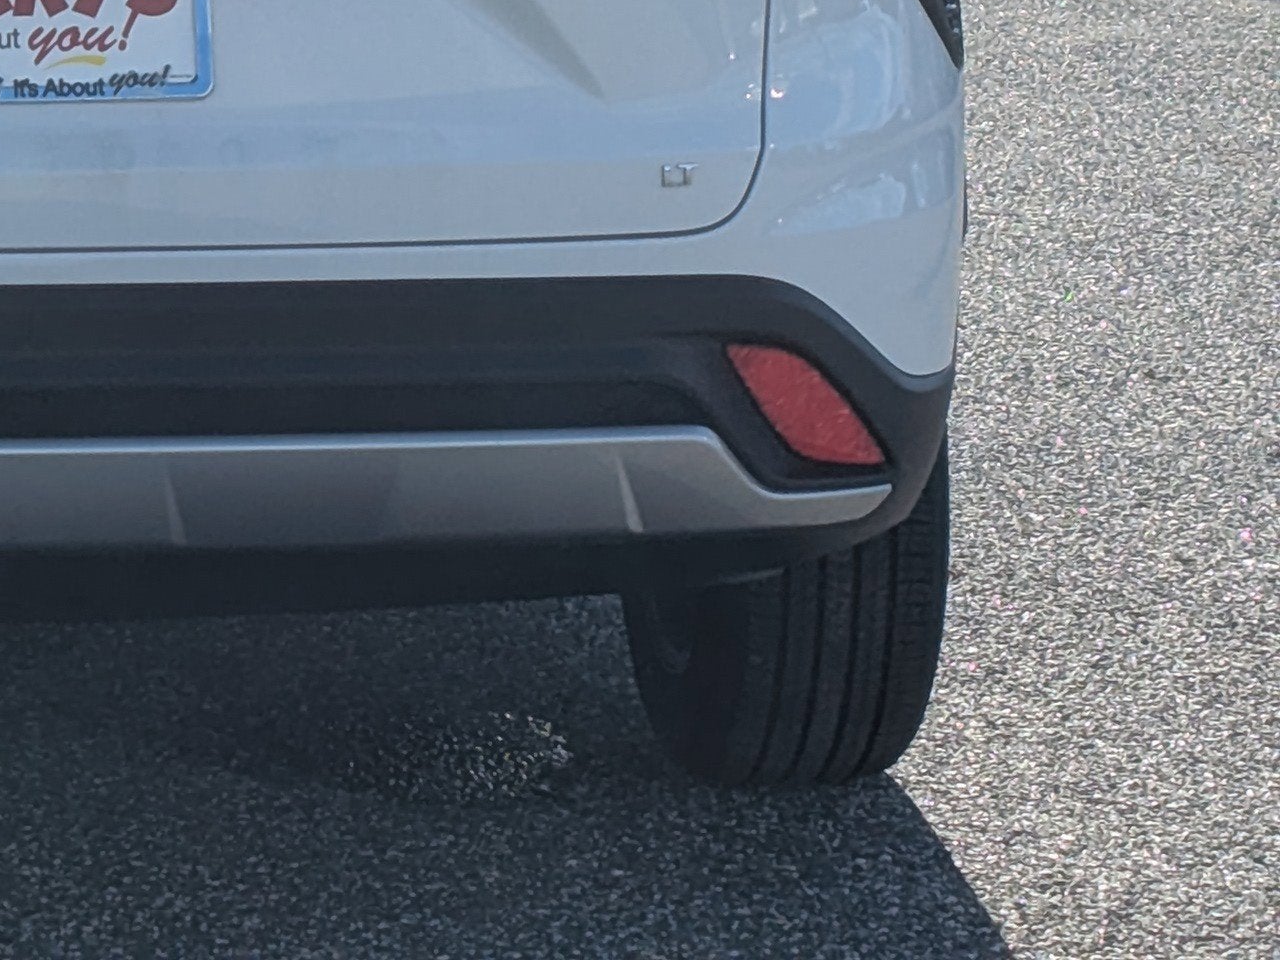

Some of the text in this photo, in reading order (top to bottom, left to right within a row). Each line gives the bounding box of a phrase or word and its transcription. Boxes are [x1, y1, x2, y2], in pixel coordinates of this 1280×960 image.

[28, 10, 138, 66] you!
[13, 78, 40, 98] It's
[42, 77, 105, 97] About
[108, 64, 171, 90] you!
[660, 161, 700, 188] LT
